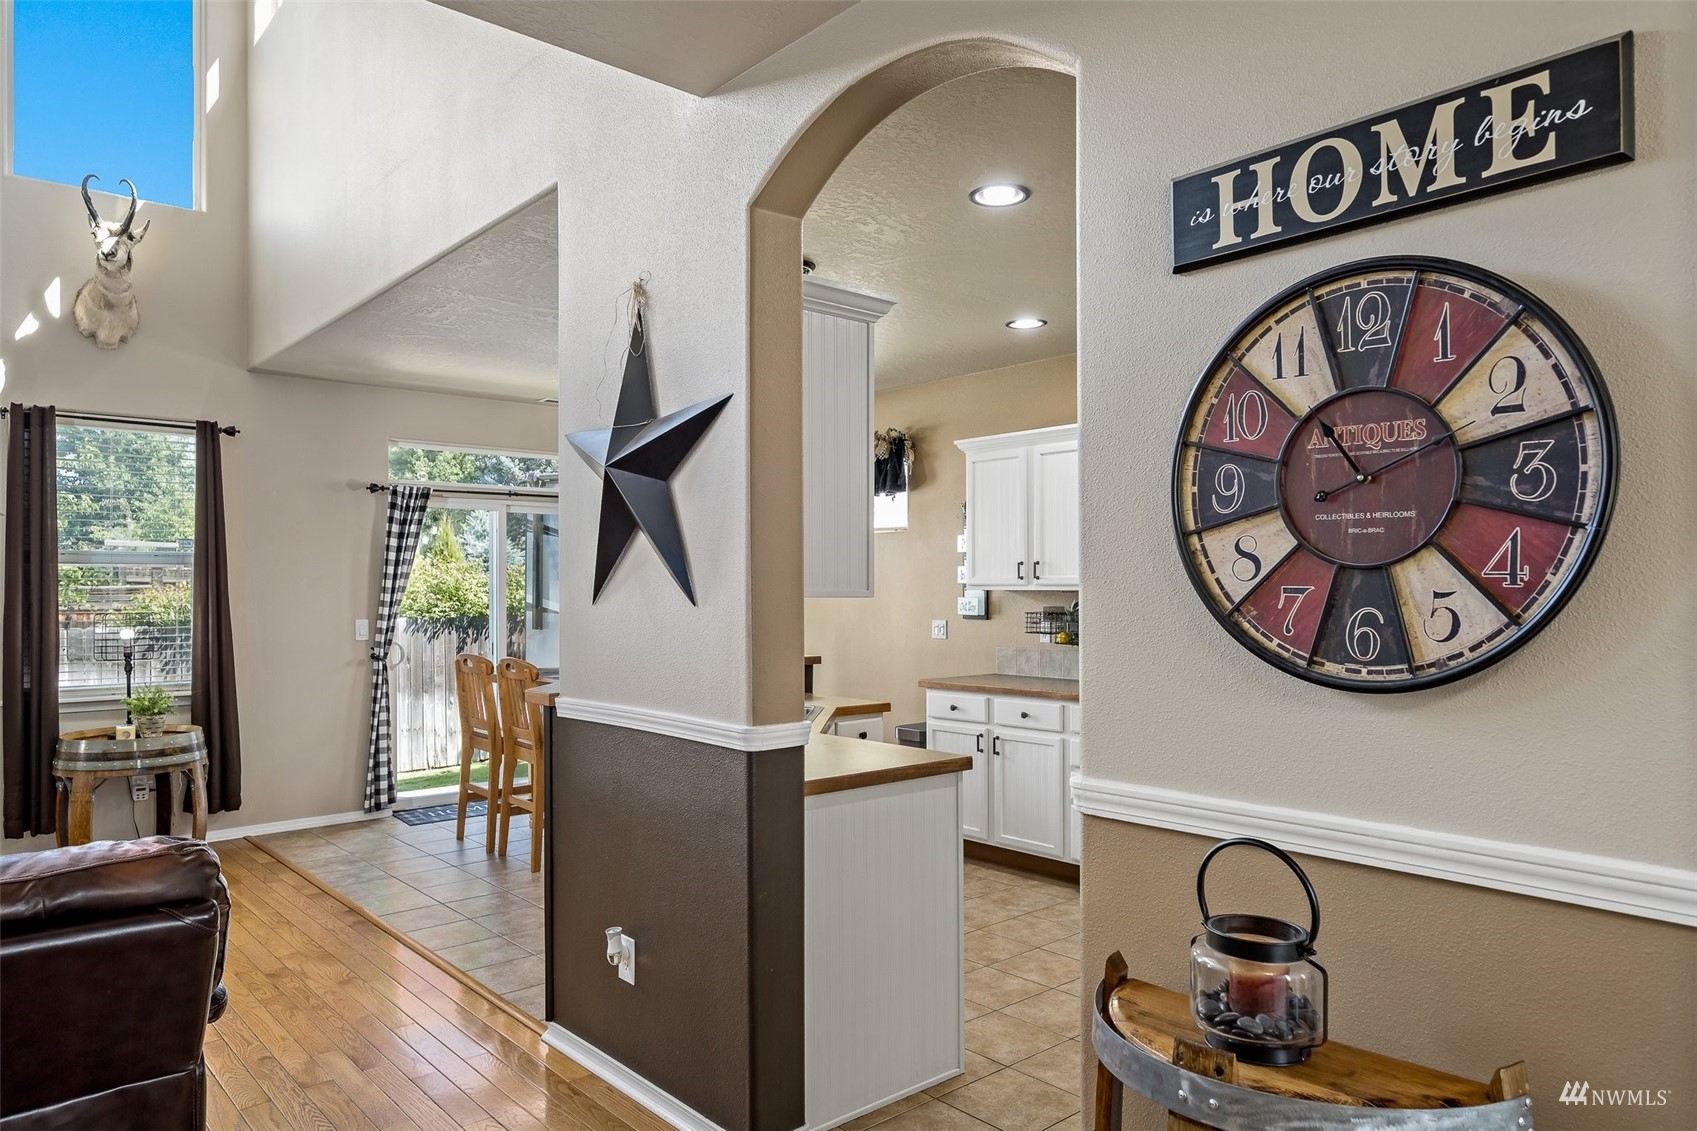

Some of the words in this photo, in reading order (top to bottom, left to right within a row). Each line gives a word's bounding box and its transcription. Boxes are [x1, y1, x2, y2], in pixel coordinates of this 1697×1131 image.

[1190, 206, 1215, 226] is
[1222, 181, 1299, 217] where
[1308, 167, 1361, 194] our
[1370, 137, 1464, 176] story
[1474, 98, 1594, 160] begins
[1211, 69, 1556, 250] HOME
[1336, 291, 1392, 353] 12
[1433, 302, 1457, 364] 1
[1272, 325, 1310, 381] 11
[1488, 355, 1527, 418] 2
[1223, 389, 1269, 443] 10
[1212, 463, 1246, 514] 9
[1510, 439, 1557, 502] 3
[1315, 512, 1365, 521] COLLECTIBLES
[1372, 510, 1416, 519] HEIRLOOMS
[1231, 534, 1263, 582] 8
[1481, 526, 1530, 588] 4
[1278, 586, 1315, 637] 7
[1346, 607, 1384, 661] 6
[1423, 589, 1462, 643] 5
